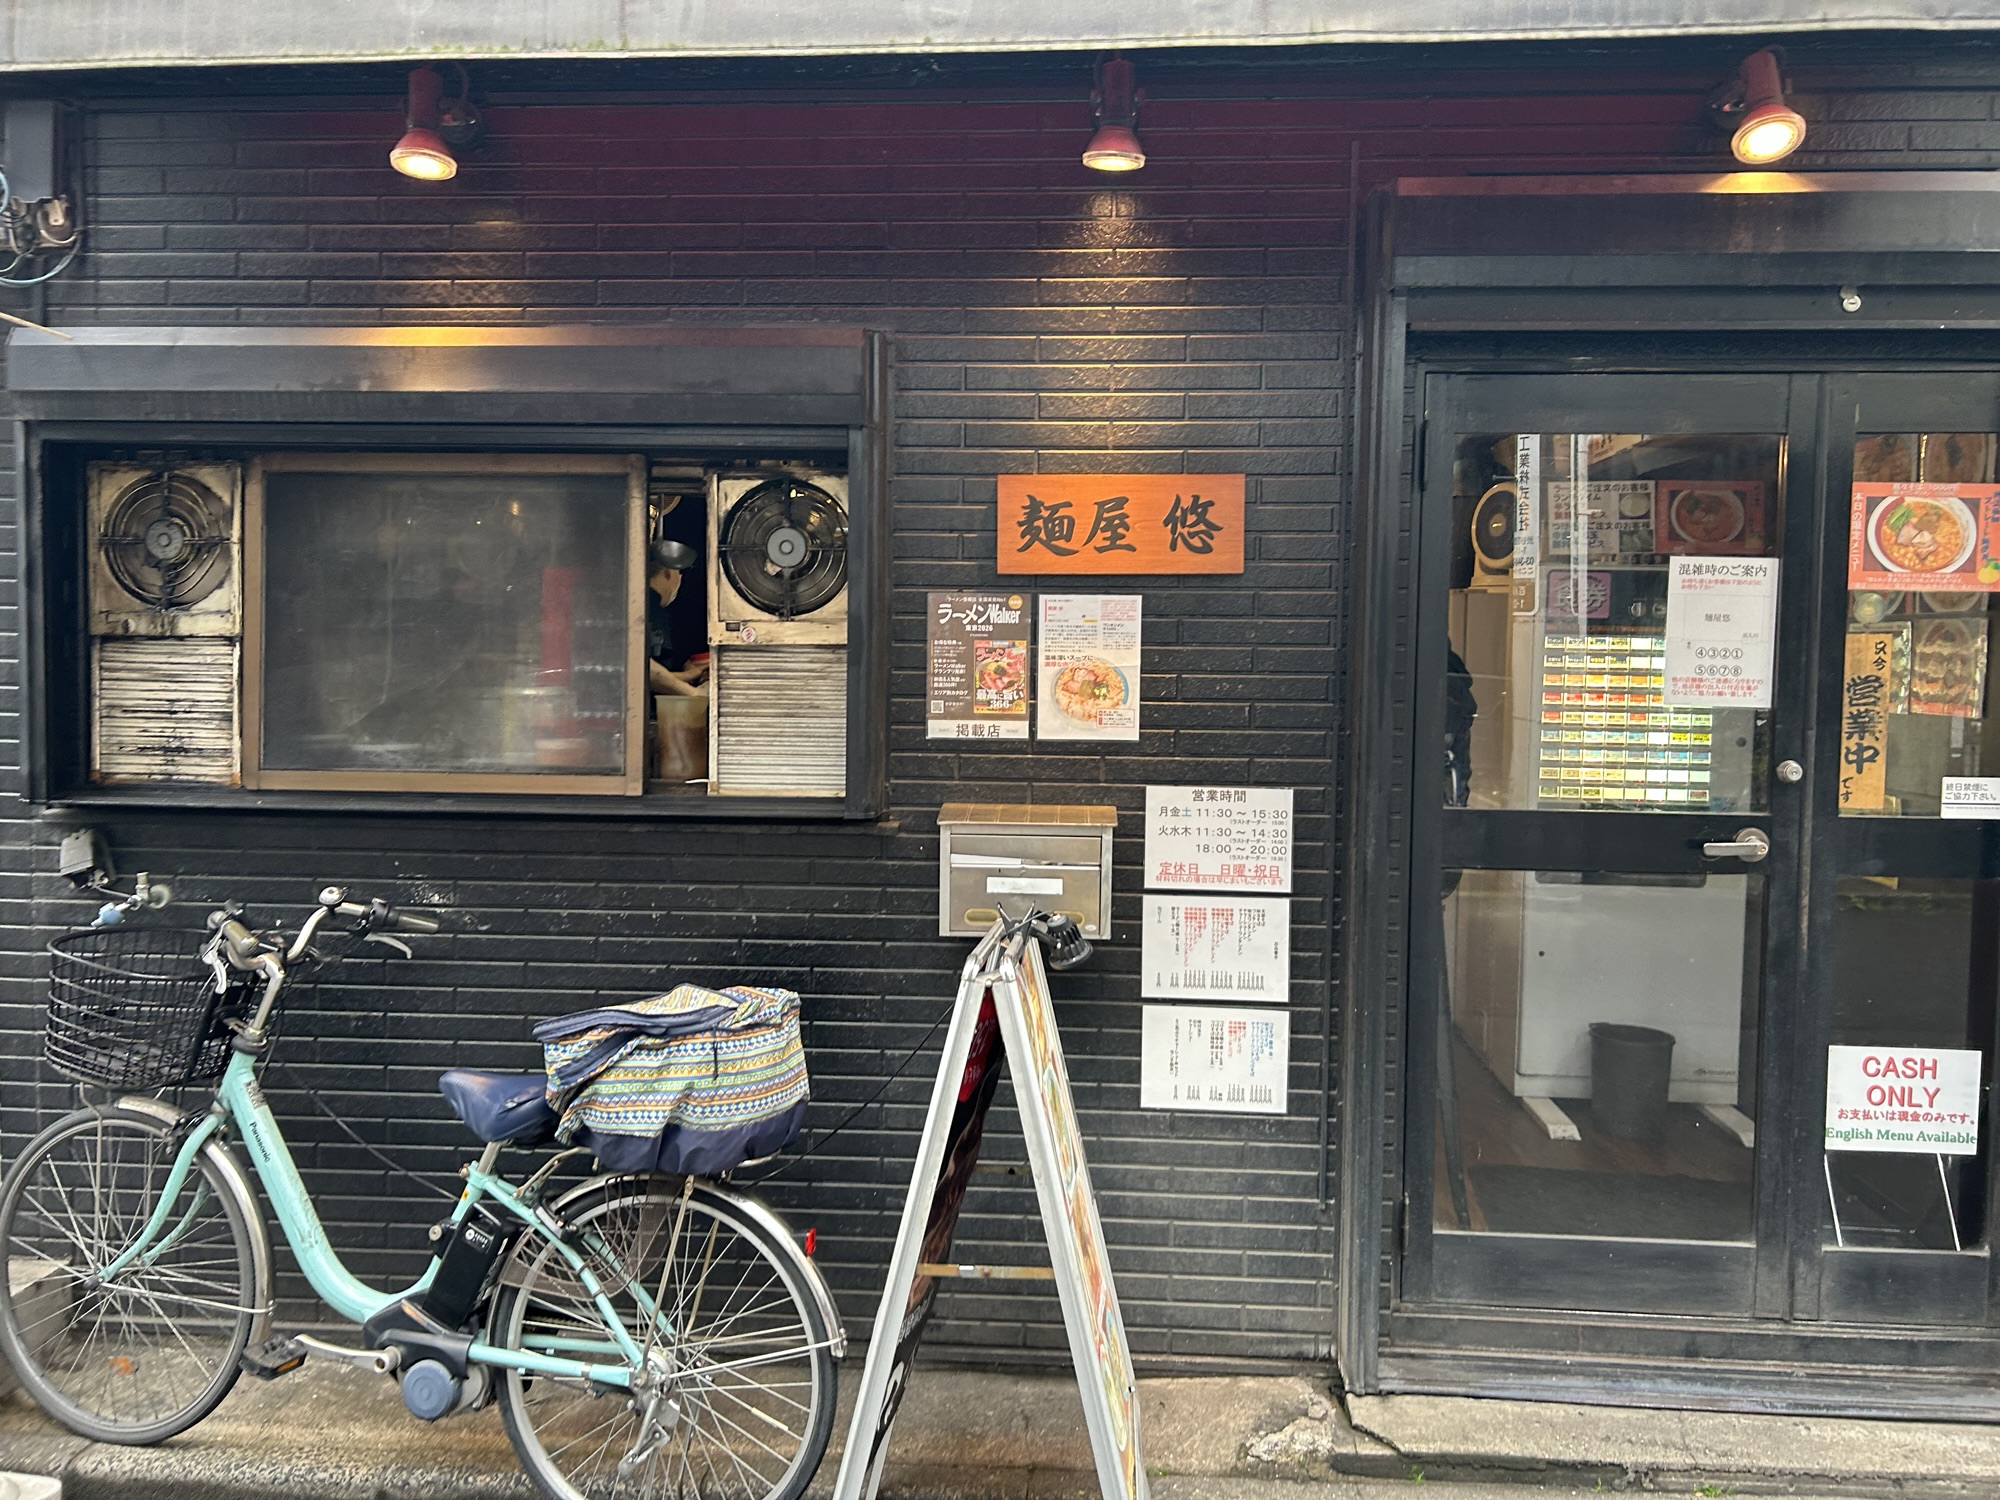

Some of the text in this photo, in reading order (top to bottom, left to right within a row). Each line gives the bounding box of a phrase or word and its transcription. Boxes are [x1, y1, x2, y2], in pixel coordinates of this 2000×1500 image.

[1162, 493, 1224, 555] 悠
[1679, 563, 1767, 578] 混雑時のご案内
[956, 723, 1001, 737] 掲載店
[1844, 674, 1884, 775] 営業中
[1945, 783, 1989, 792] 終日禁煙に
[1192, 789, 1247, 803] 営業時間
[1158, 806, 1192, 818] 月金土
[1196, 808, 1232, 818] 11:30
[1252, 810, 1288, 820] 15:30
[1158, 825, 1192, 837] 火水木
[1196, 827, 1232, 837] 11:30
[1252, 829, 1288, 839] 14:30
[1196, 844, 1231, 854] 18:00
[1250, 845, 1287, 855] 20:00
[1160, 862, 1199, 875] 定休日
[1862, 1056, 1938, 1080] CASH
[1866, 1084, 1941, 1108] ONLY
[1837, 1108, 1975, 1125] お支払いは現金のみです。
[249, 1121, 270, 1163] Panasonic
[1825, 1127, 1977, 1144] English Menu Available
